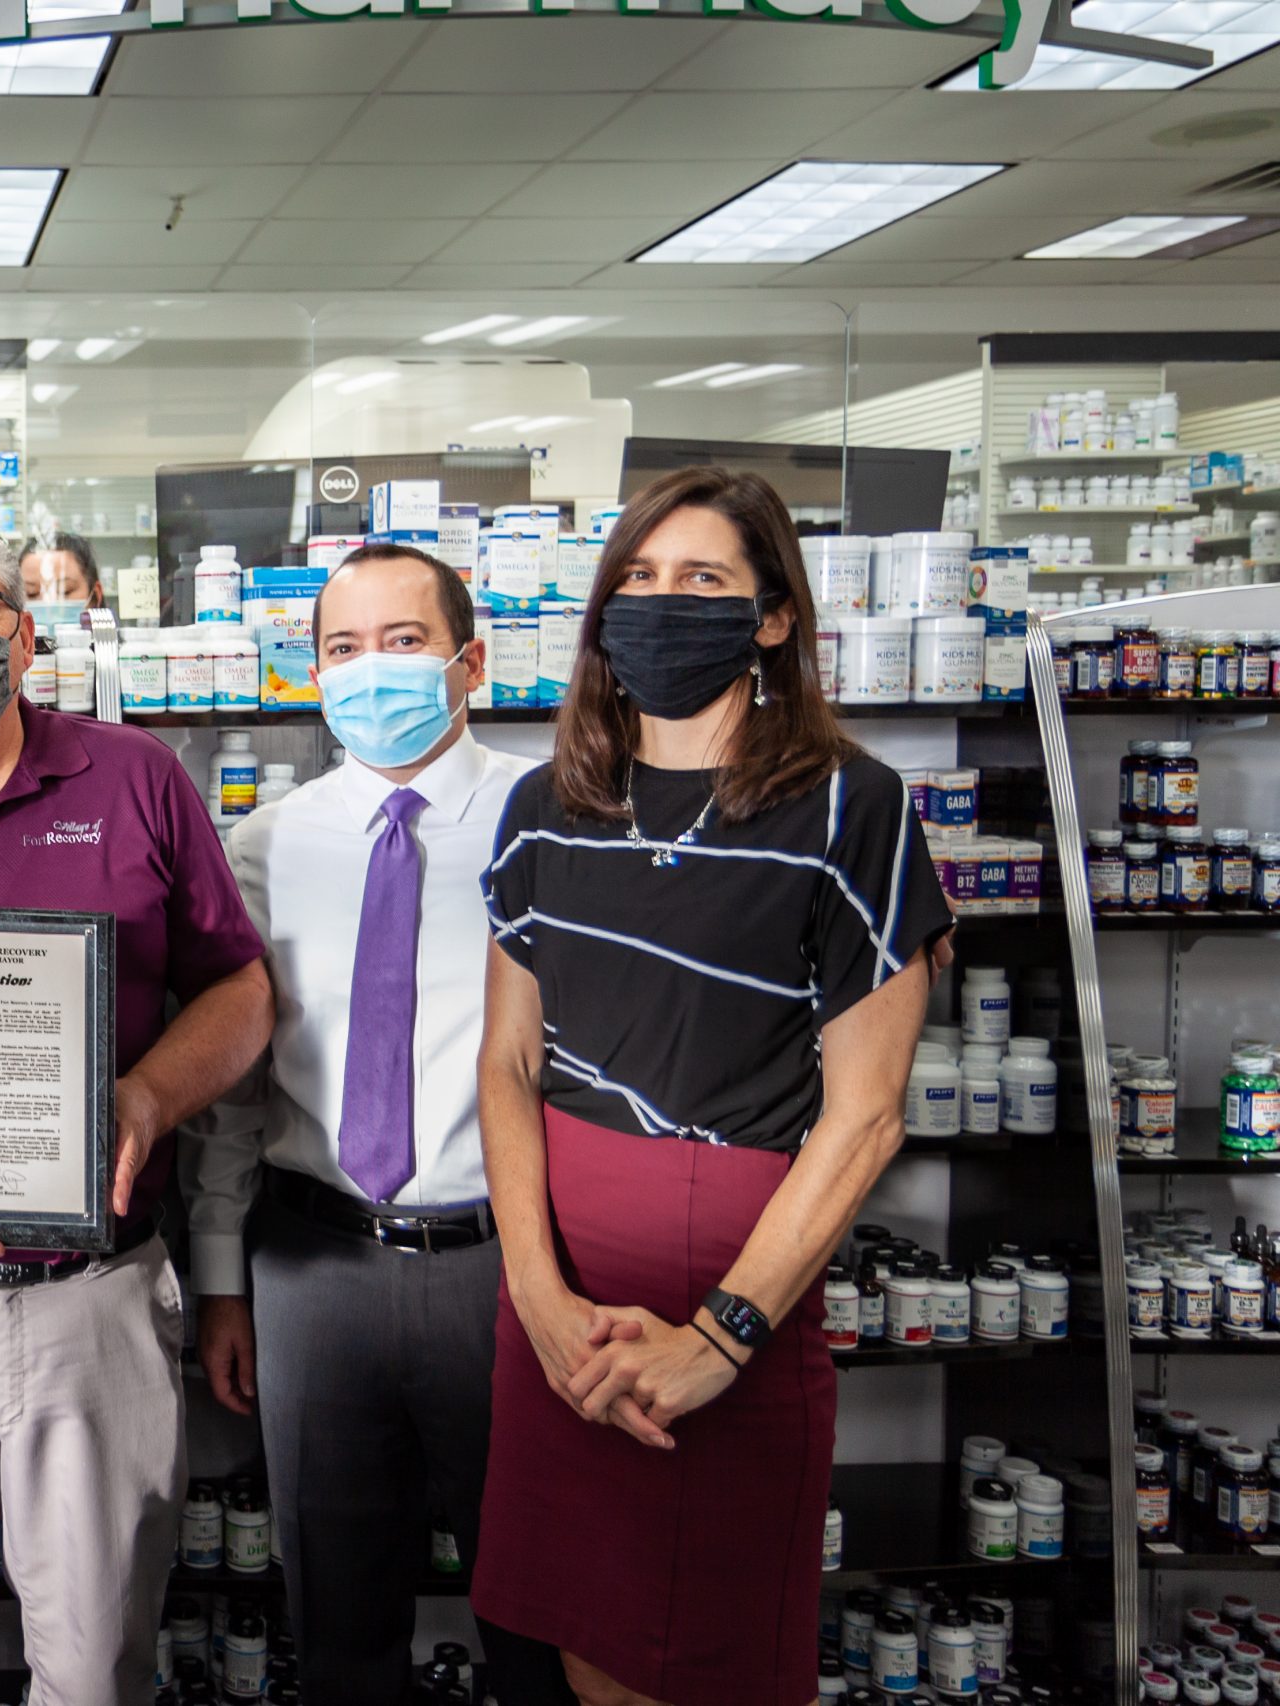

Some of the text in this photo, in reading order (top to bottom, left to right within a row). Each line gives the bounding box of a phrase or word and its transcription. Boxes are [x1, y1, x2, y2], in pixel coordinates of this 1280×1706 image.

[323, 478, 355, 490] DELL
[439, 537, 472, 545] MMUNE
[928, 566, 951, 575] KIDS
[273, 617, 312, 627] Childre
[547, 644, 575, 652] OMEG
[876, 650, 898, 659] KIDS
[942, 650, 963, 659] KIDS
[946, 795, 971, 810] GABA
[1014, 864, 1039, 874] METHYL
[981, 867, 1006, 882] GABA
[1014, 873, 1038, 883] FOLATE
